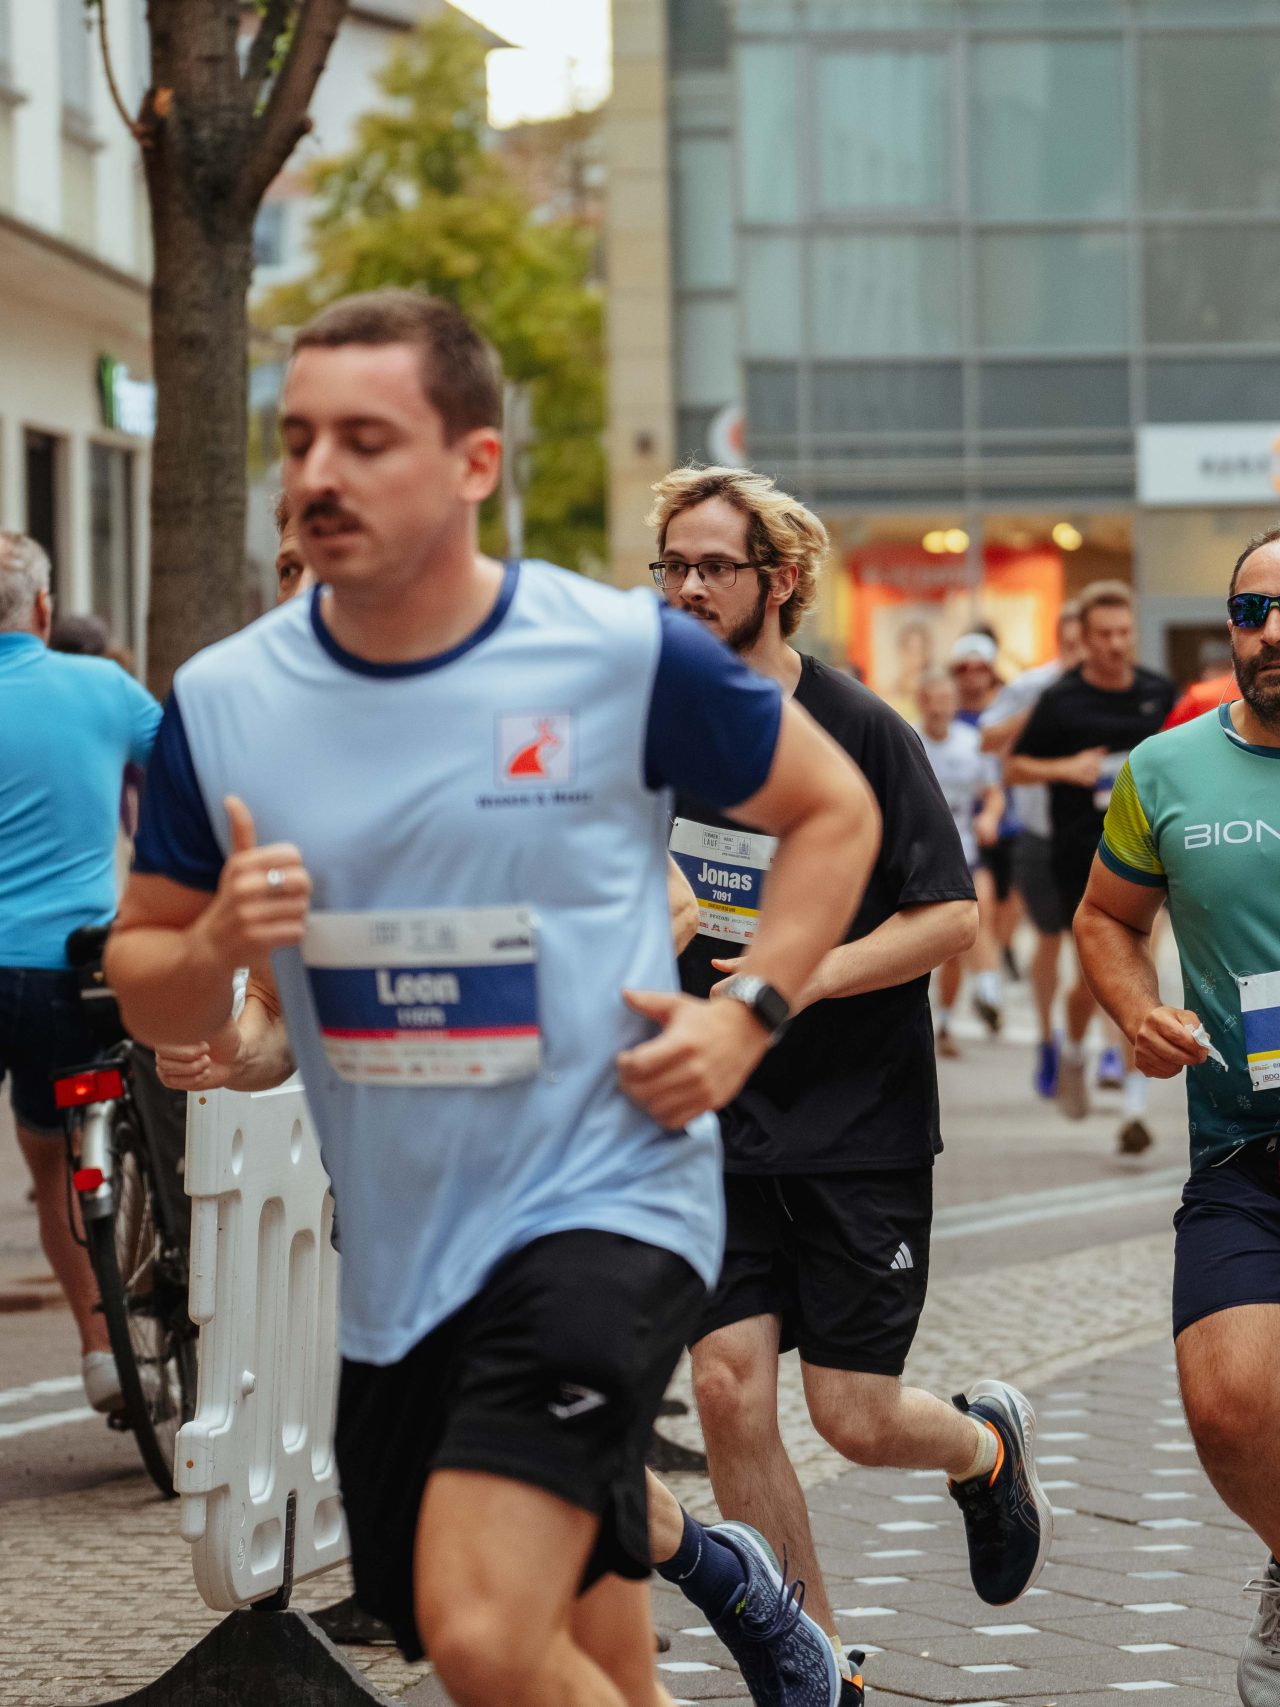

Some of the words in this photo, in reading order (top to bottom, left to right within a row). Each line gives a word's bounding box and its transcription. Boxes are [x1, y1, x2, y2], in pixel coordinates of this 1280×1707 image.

[698, 862, 753, 891] Jonas
[712, 889, 732, 903] 7091
[376, 968, 460, 1006] Leon
[1264, 1072, 1280, 1082] BDO
